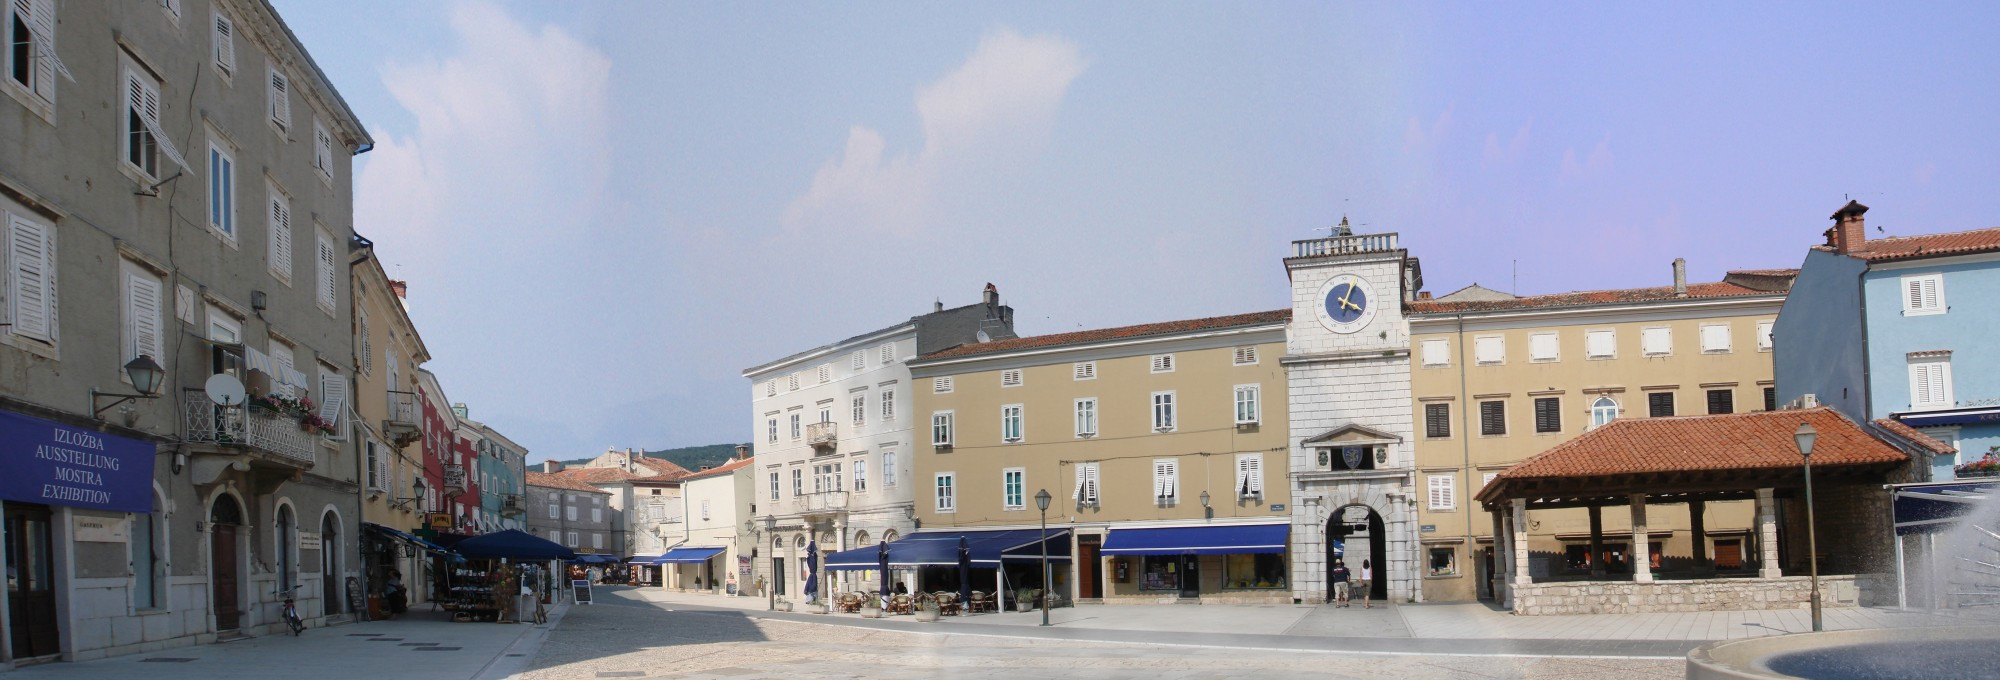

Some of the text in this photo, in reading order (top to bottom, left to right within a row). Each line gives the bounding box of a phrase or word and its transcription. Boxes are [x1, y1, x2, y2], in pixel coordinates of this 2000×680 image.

[54, 428, 104, 450] IZLOŽBA
[35, 444, 119, 471] AUSSTELLUNG
[55, 466, 103, 486] MOSTRA
[42, 484, 111, 504] EXHIBITION
